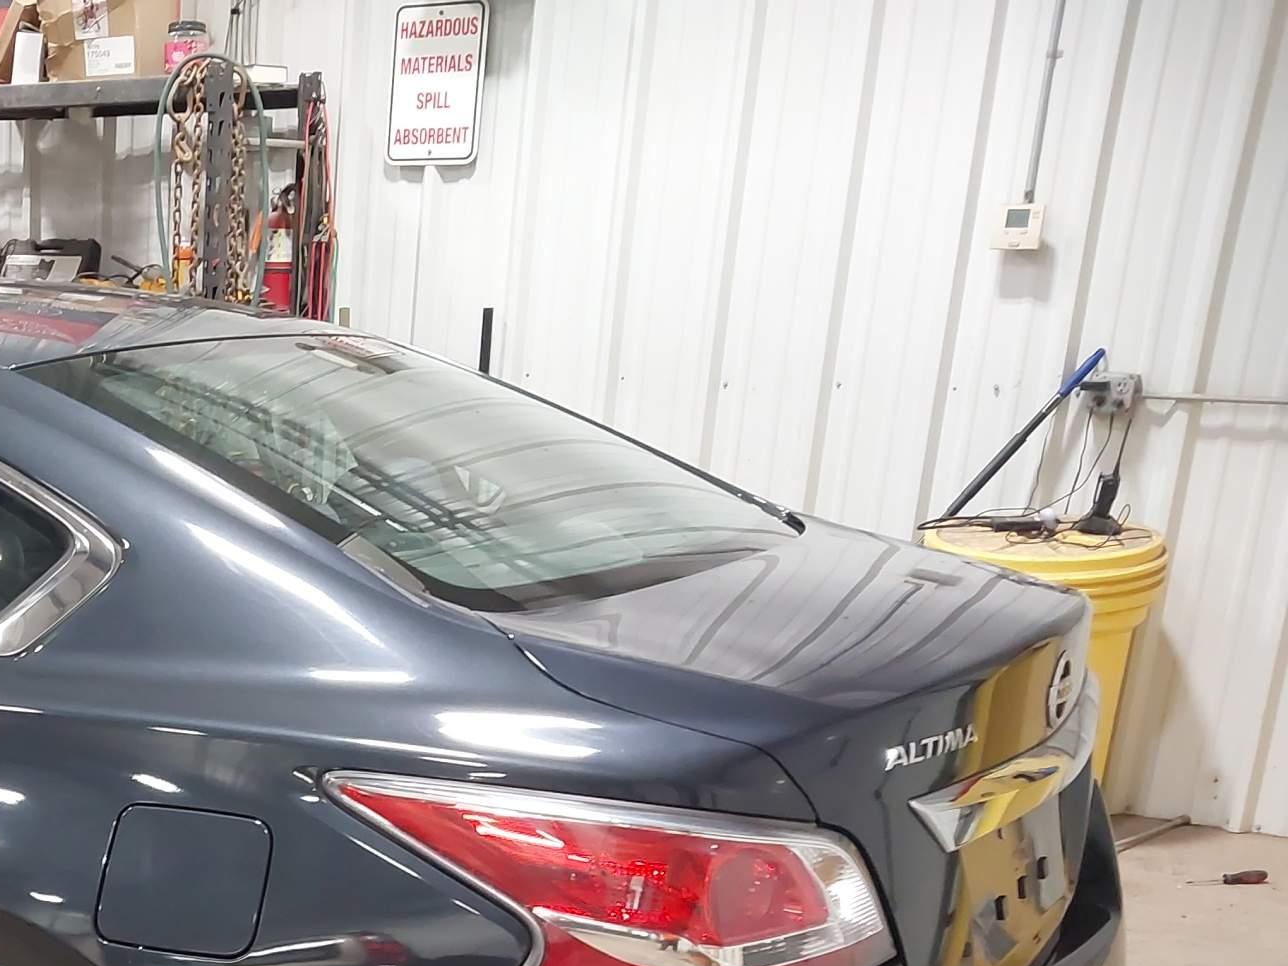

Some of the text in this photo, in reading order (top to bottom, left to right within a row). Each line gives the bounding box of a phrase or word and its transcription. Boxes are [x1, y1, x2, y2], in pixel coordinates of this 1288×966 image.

[400, 16, 479, 39] HAZARDOUS
[400, 53, 473, 75] MATERIALS
[416, 91, 451, 110] SPILL
[393, 126, 469, 145] ABSORBENT
[884, 723, 979, 772] ALTIMA
